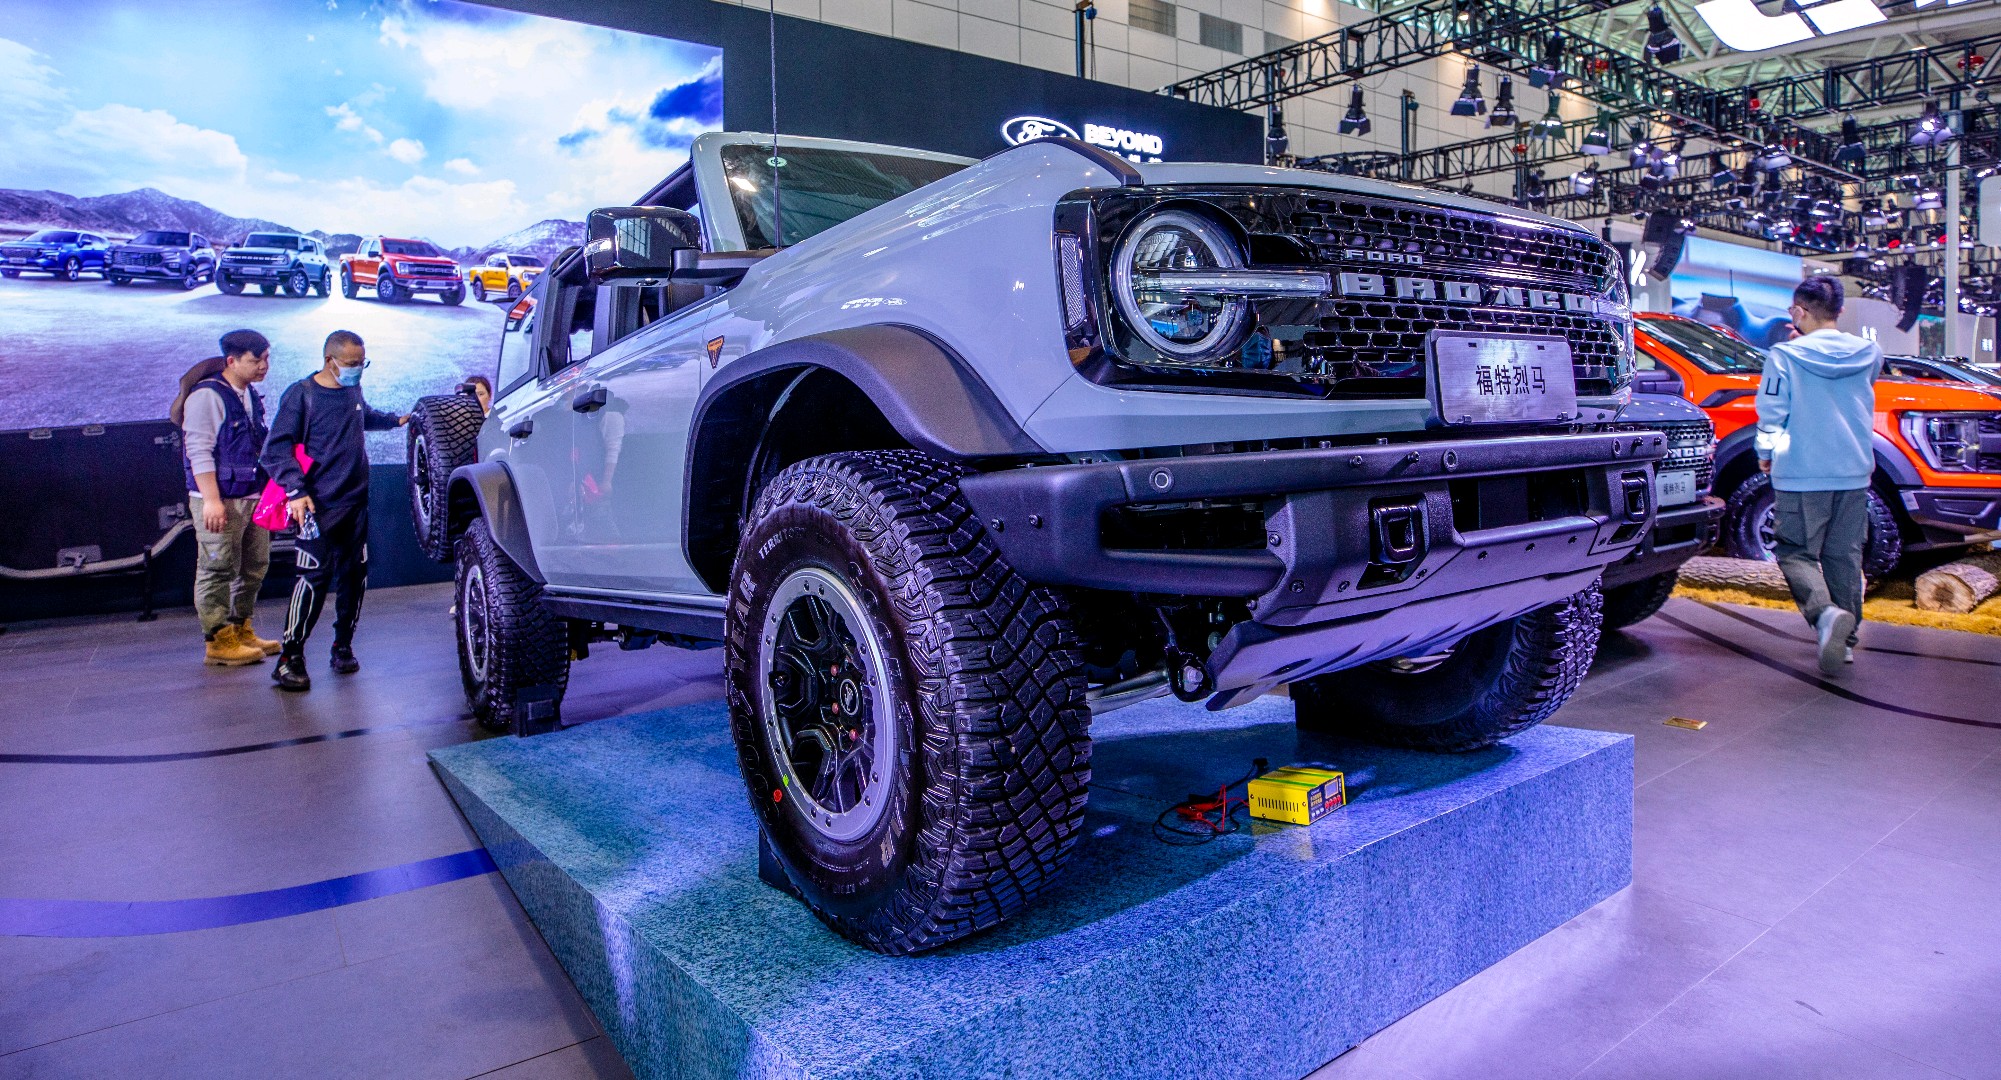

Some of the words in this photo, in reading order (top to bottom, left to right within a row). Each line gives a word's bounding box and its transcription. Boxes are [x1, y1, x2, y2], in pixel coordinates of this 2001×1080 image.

[1084, 123, 1163, 155] BEYOND
[1344, 249, 1423, 265] FORD
[1340, 271, 1592, 313] BRONCO
[1476, 364, 1546, 396] 福特烈马
[1664, 446, 1706, 459] NCO
